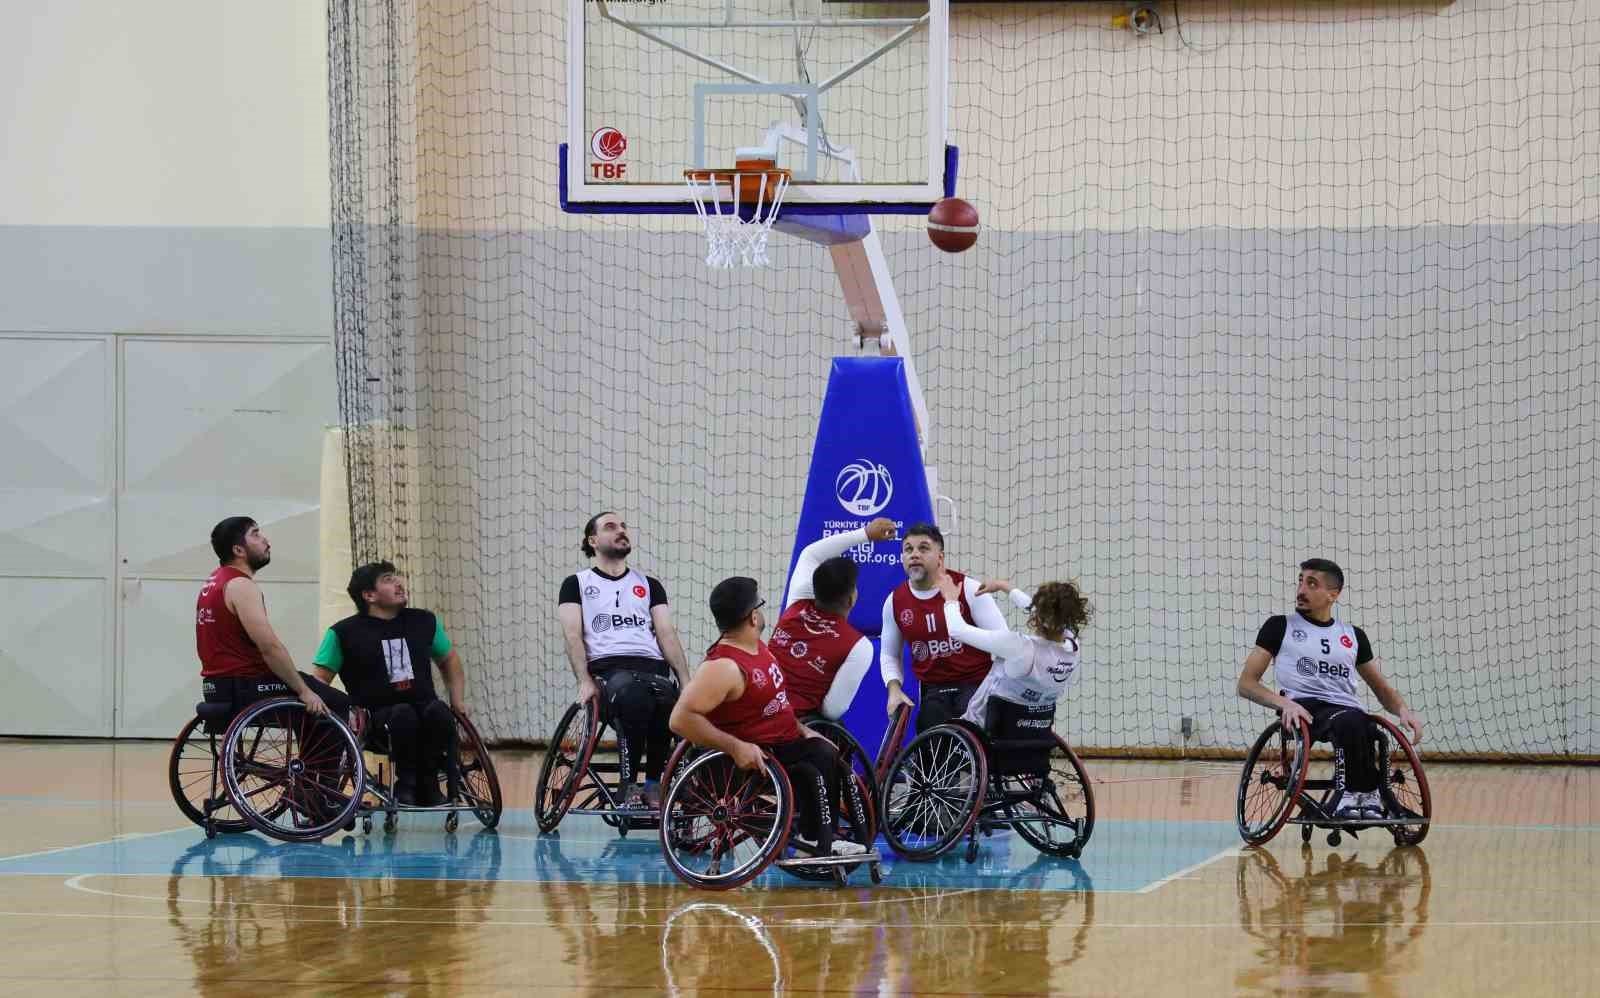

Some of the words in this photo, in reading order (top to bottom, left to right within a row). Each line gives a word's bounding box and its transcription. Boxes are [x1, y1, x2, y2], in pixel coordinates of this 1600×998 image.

[591, 163, 626, 178] TBF
[611, 614, 646, 627] Beta
[925, 613, 937, 632] 11
[928, 638, 962, 654] Beta
[1320, 639, 1330, 654] 5
[1319, 661, 1350, 679] Beta
[257, 683, 288, 692] EXTRA
